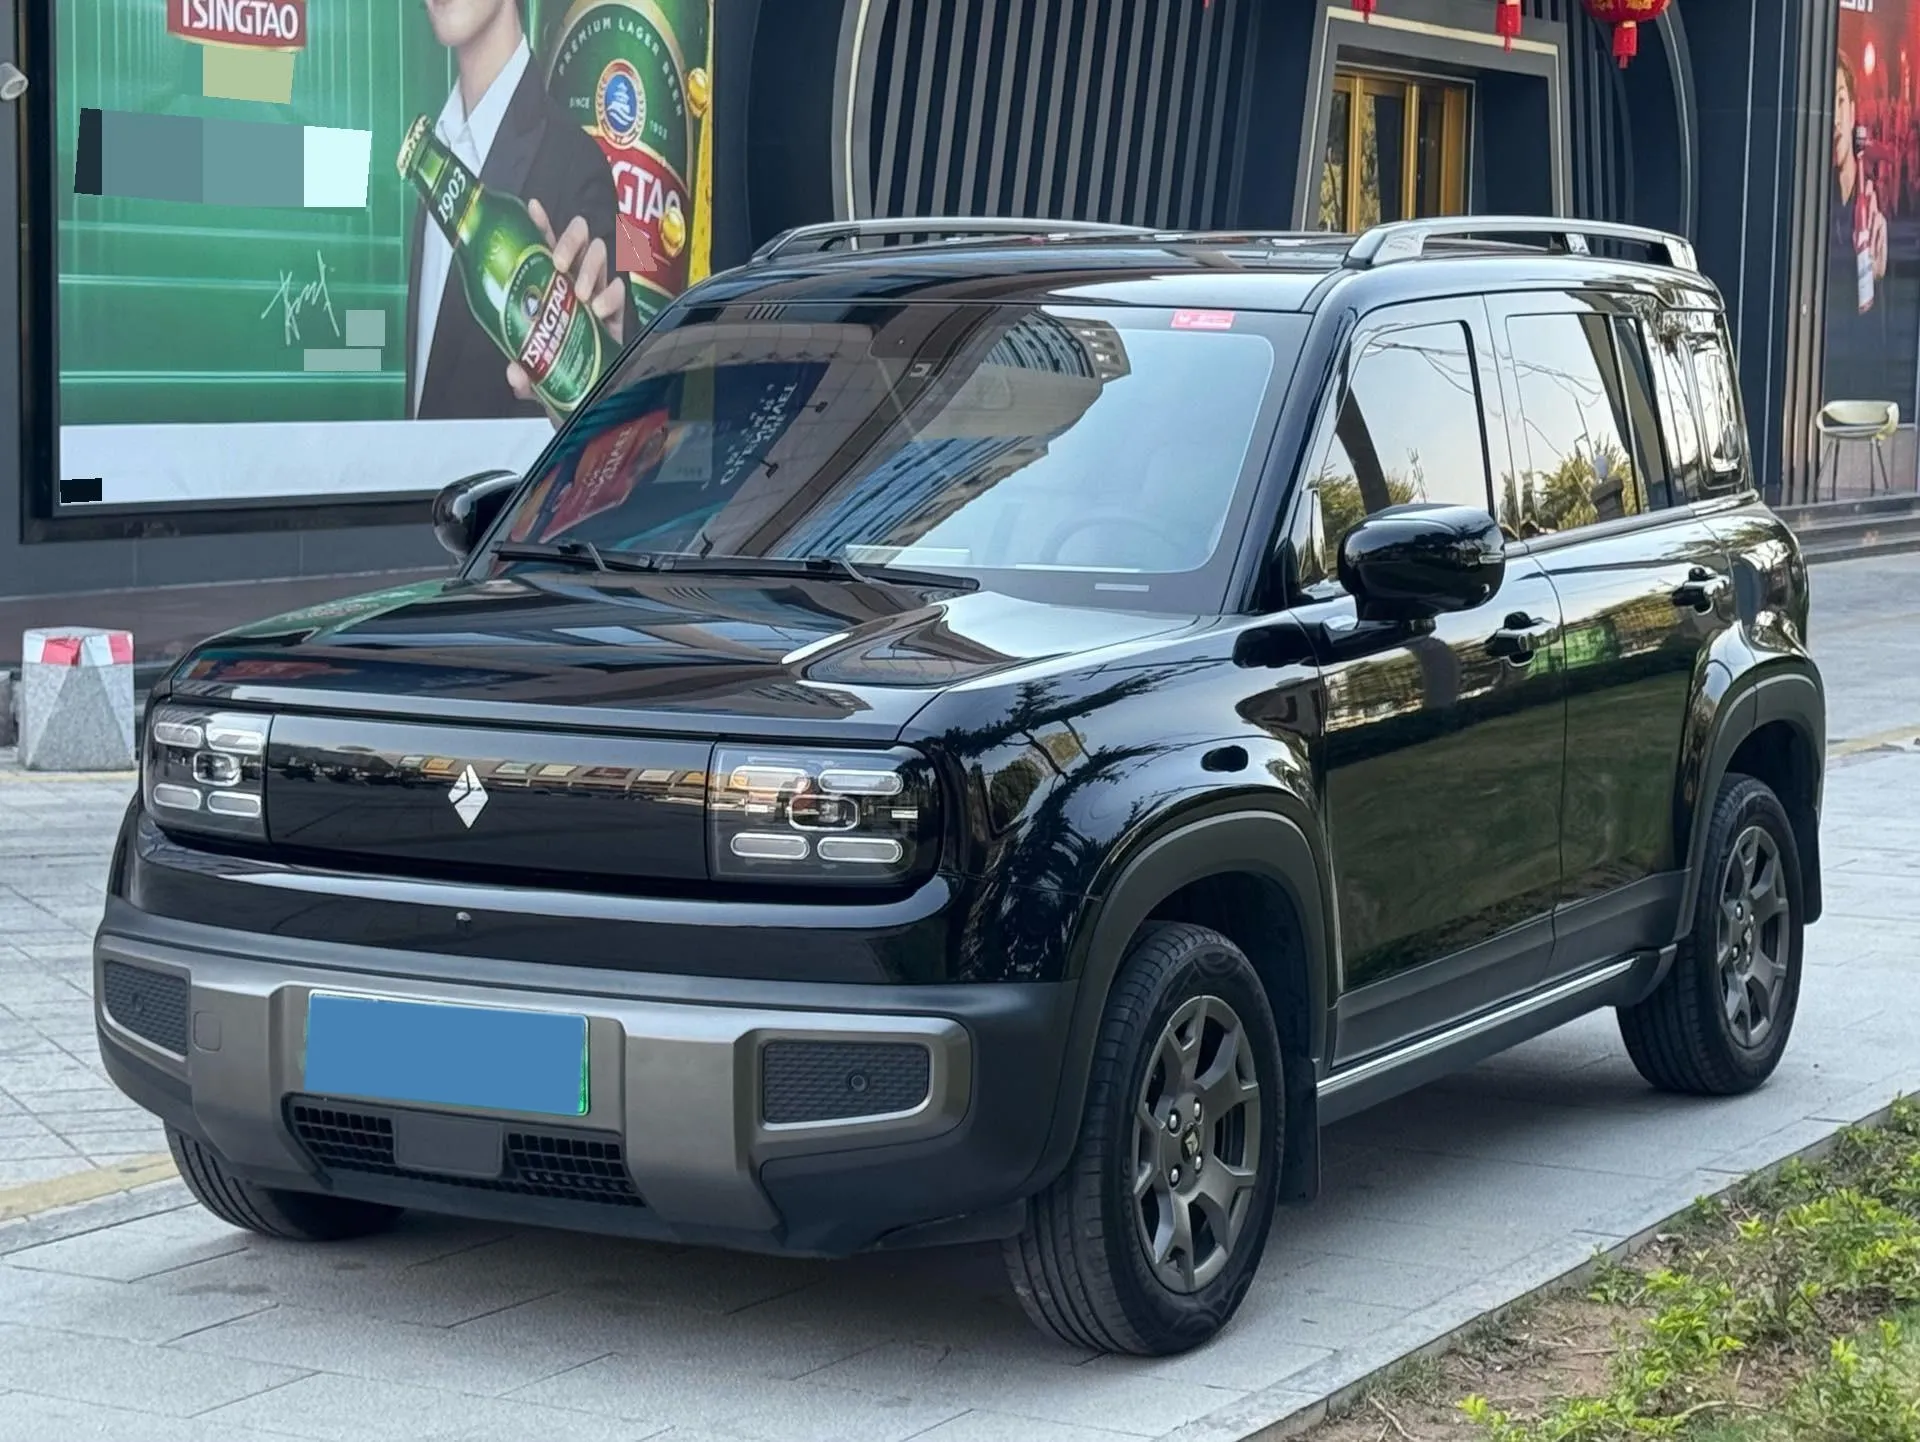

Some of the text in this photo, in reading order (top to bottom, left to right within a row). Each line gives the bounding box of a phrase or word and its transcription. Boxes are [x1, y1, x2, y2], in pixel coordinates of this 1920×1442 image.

[618, 17, 660, 57] LAGER
[437, 166, 467, 224] 1903
[521, 274, 569, 368] TSINGTAO
